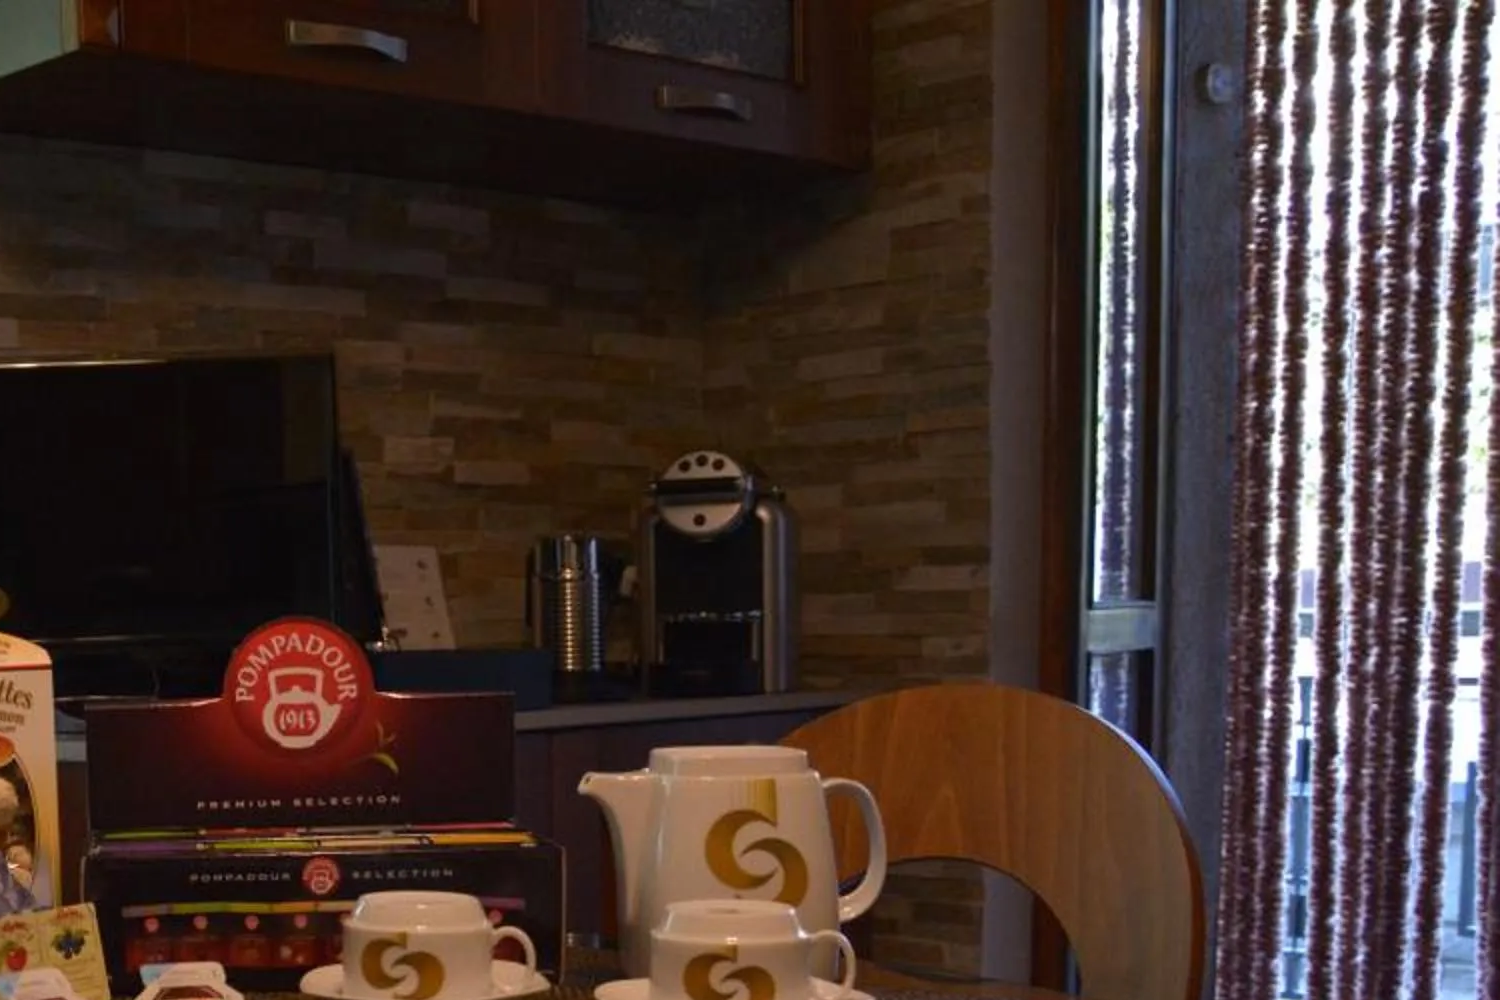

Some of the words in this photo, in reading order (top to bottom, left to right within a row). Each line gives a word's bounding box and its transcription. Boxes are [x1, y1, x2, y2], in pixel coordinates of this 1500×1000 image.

[233, 631, 359, 703] POMPADOUR
[278, 708, 317, 732] 1913
[195, 798, 282, 810] PREMIUM
[292, 794, 402, 808] SELECTION
[189, 871, 292, 883] POMPADOUR
[351, 867, 454, 881] SELECTION
